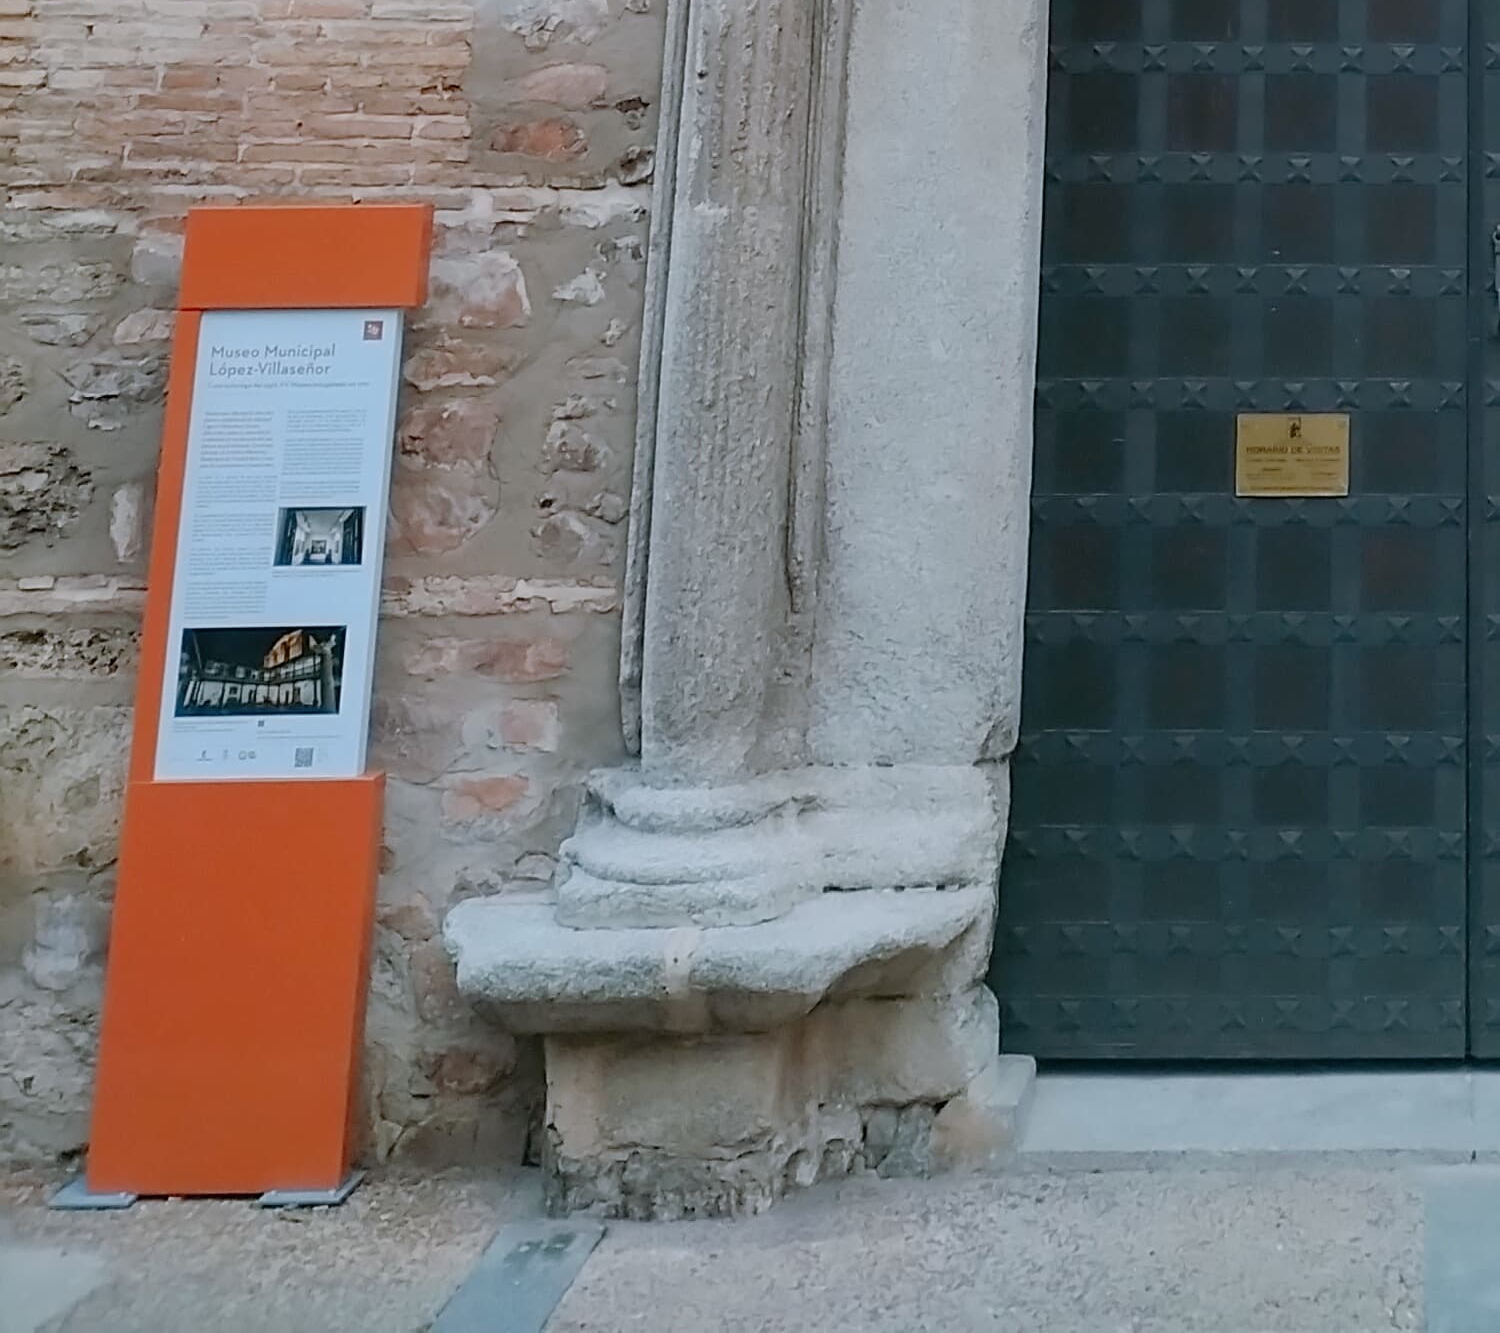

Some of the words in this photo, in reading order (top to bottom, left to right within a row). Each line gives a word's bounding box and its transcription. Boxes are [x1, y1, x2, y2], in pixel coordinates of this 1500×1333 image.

[211, 345, 260, 359] Museo
[264, 343, 336, 361] Municipal
[209, 361, 331, 378] López-Villaseñor
